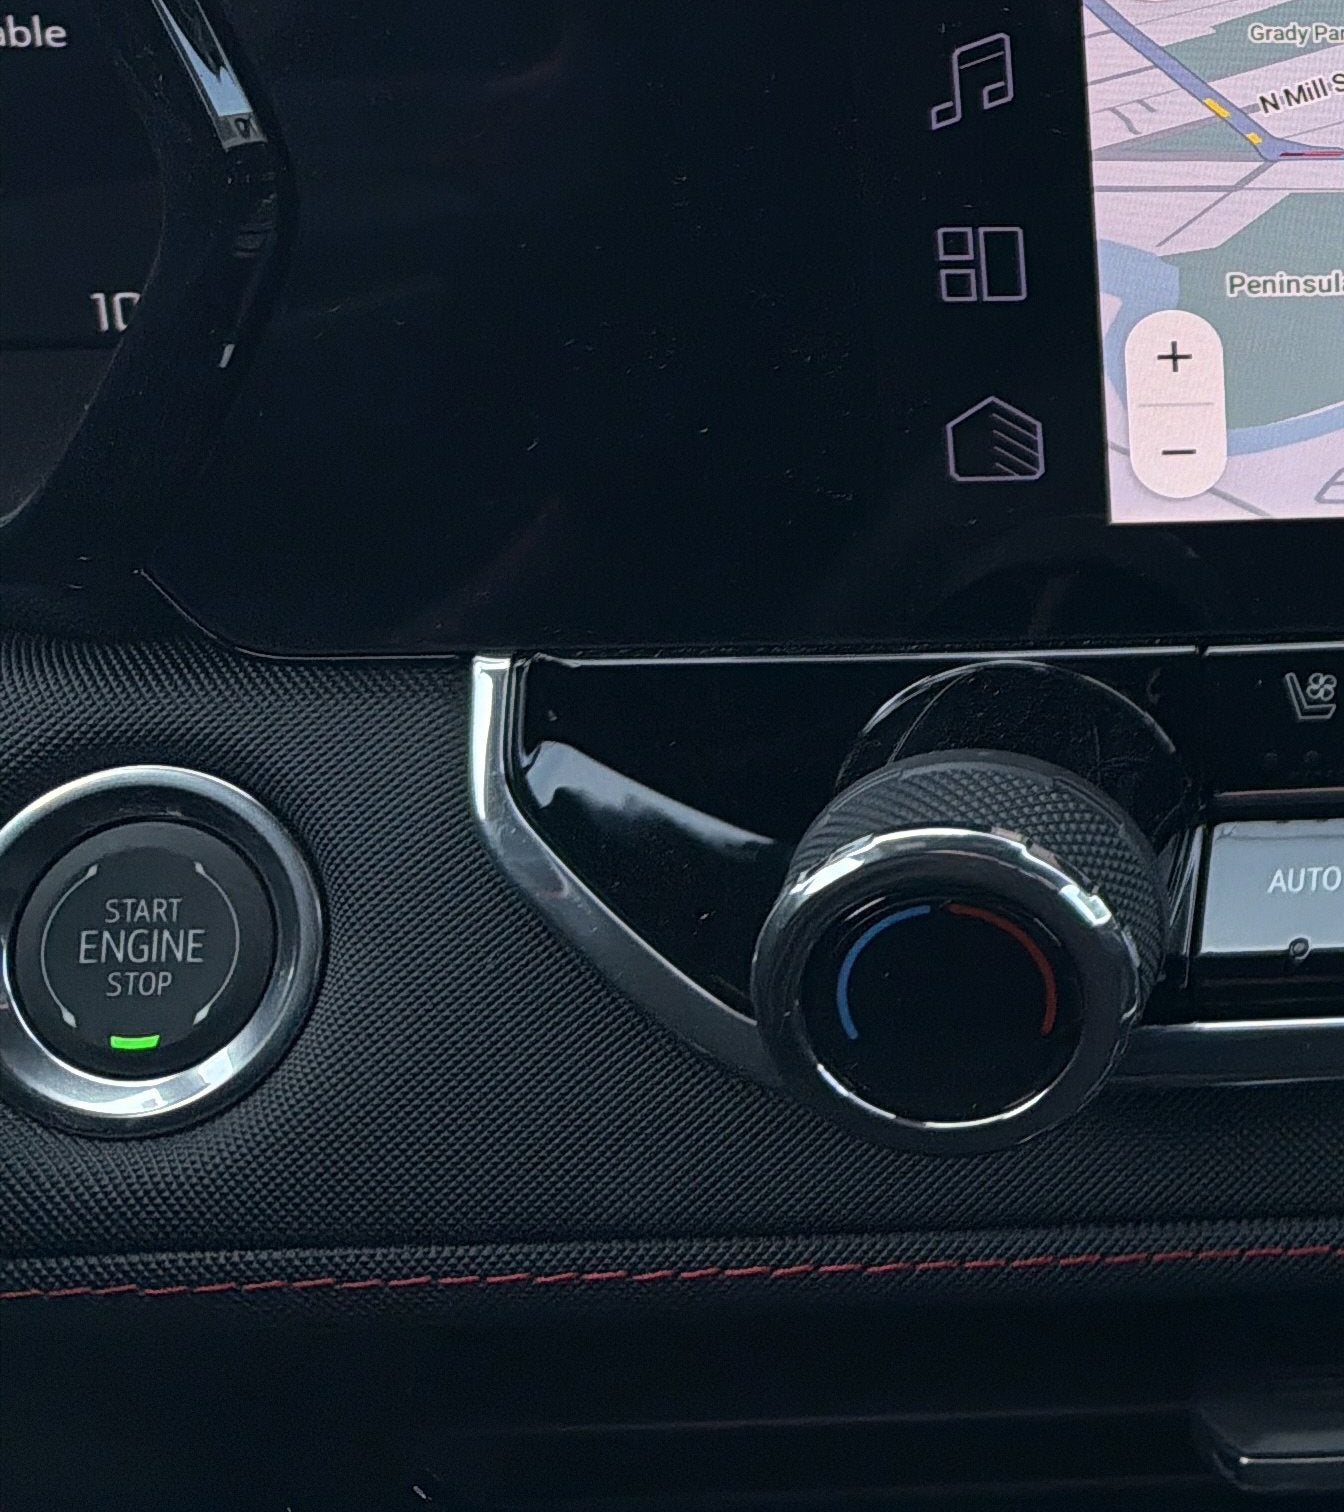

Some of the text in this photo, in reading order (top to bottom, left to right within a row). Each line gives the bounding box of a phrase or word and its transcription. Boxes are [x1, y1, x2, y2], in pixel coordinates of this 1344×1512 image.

[1250, 25, 1309, 45] Grady
[1259, 95, 1280, 114] N
[1283, 78, 1328, 107] Mill
[1267, 865, 1342, 895] AUTO
[105, 898, 182, 923] START
[78, 929, 205, 965] ENGINE
[106, 971, 173, 997] STOP
